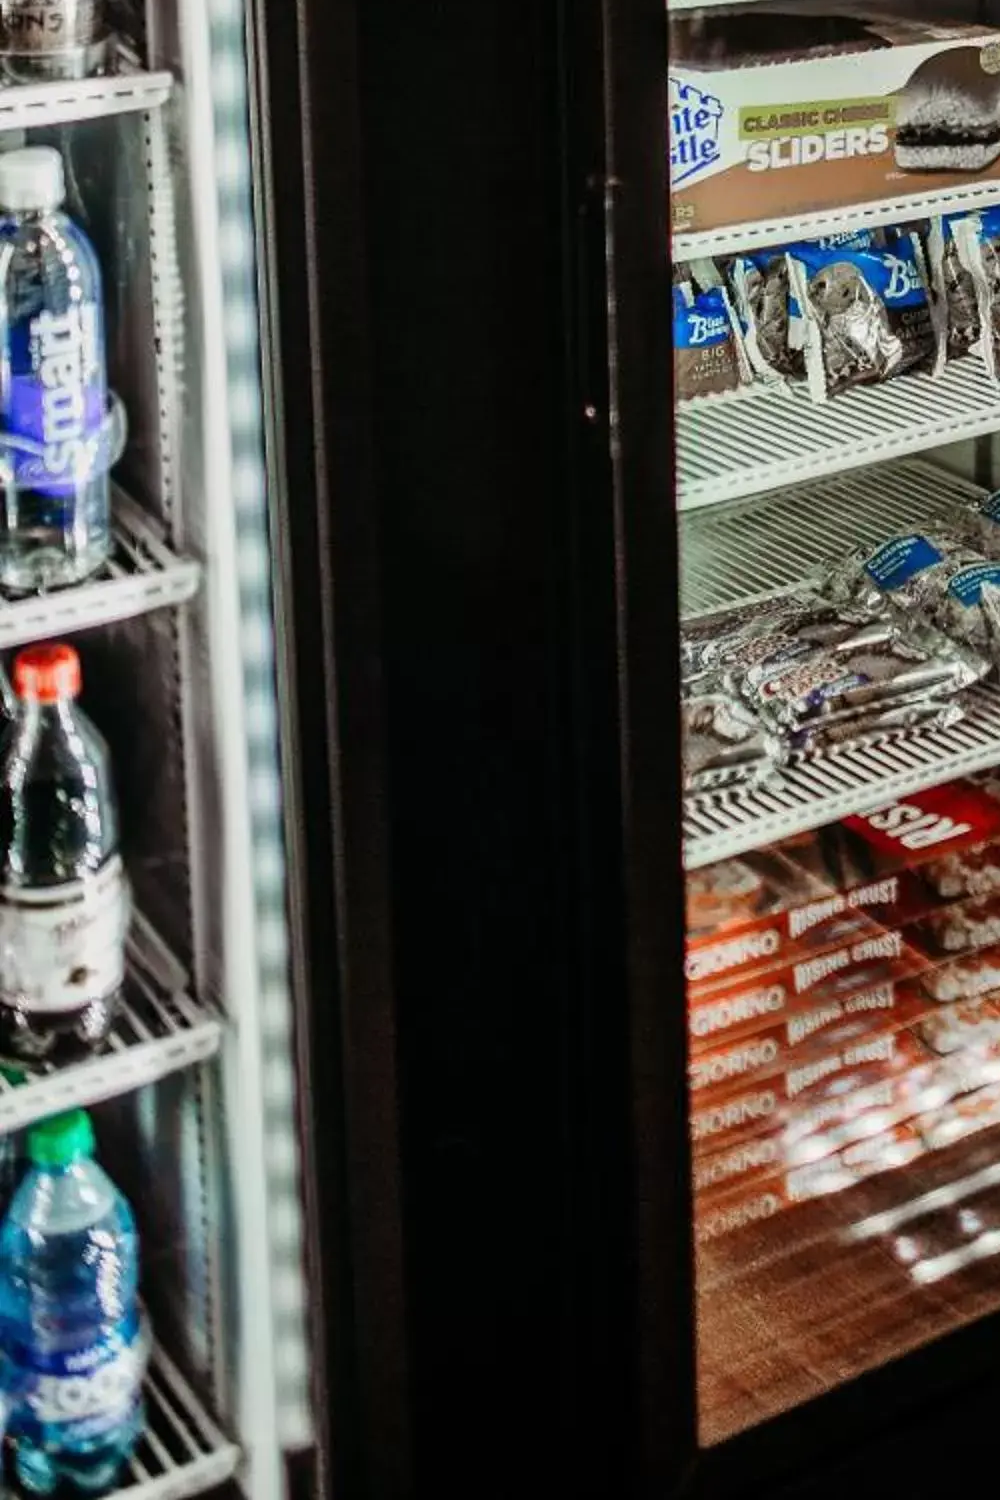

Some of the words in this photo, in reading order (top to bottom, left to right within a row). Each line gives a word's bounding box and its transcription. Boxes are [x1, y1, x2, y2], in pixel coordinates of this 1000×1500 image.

[746, 122, 889, 172] SLIDERS
[857, 803, 972, 850] RIS
[690, 985, 785, 1037] GIORNO
